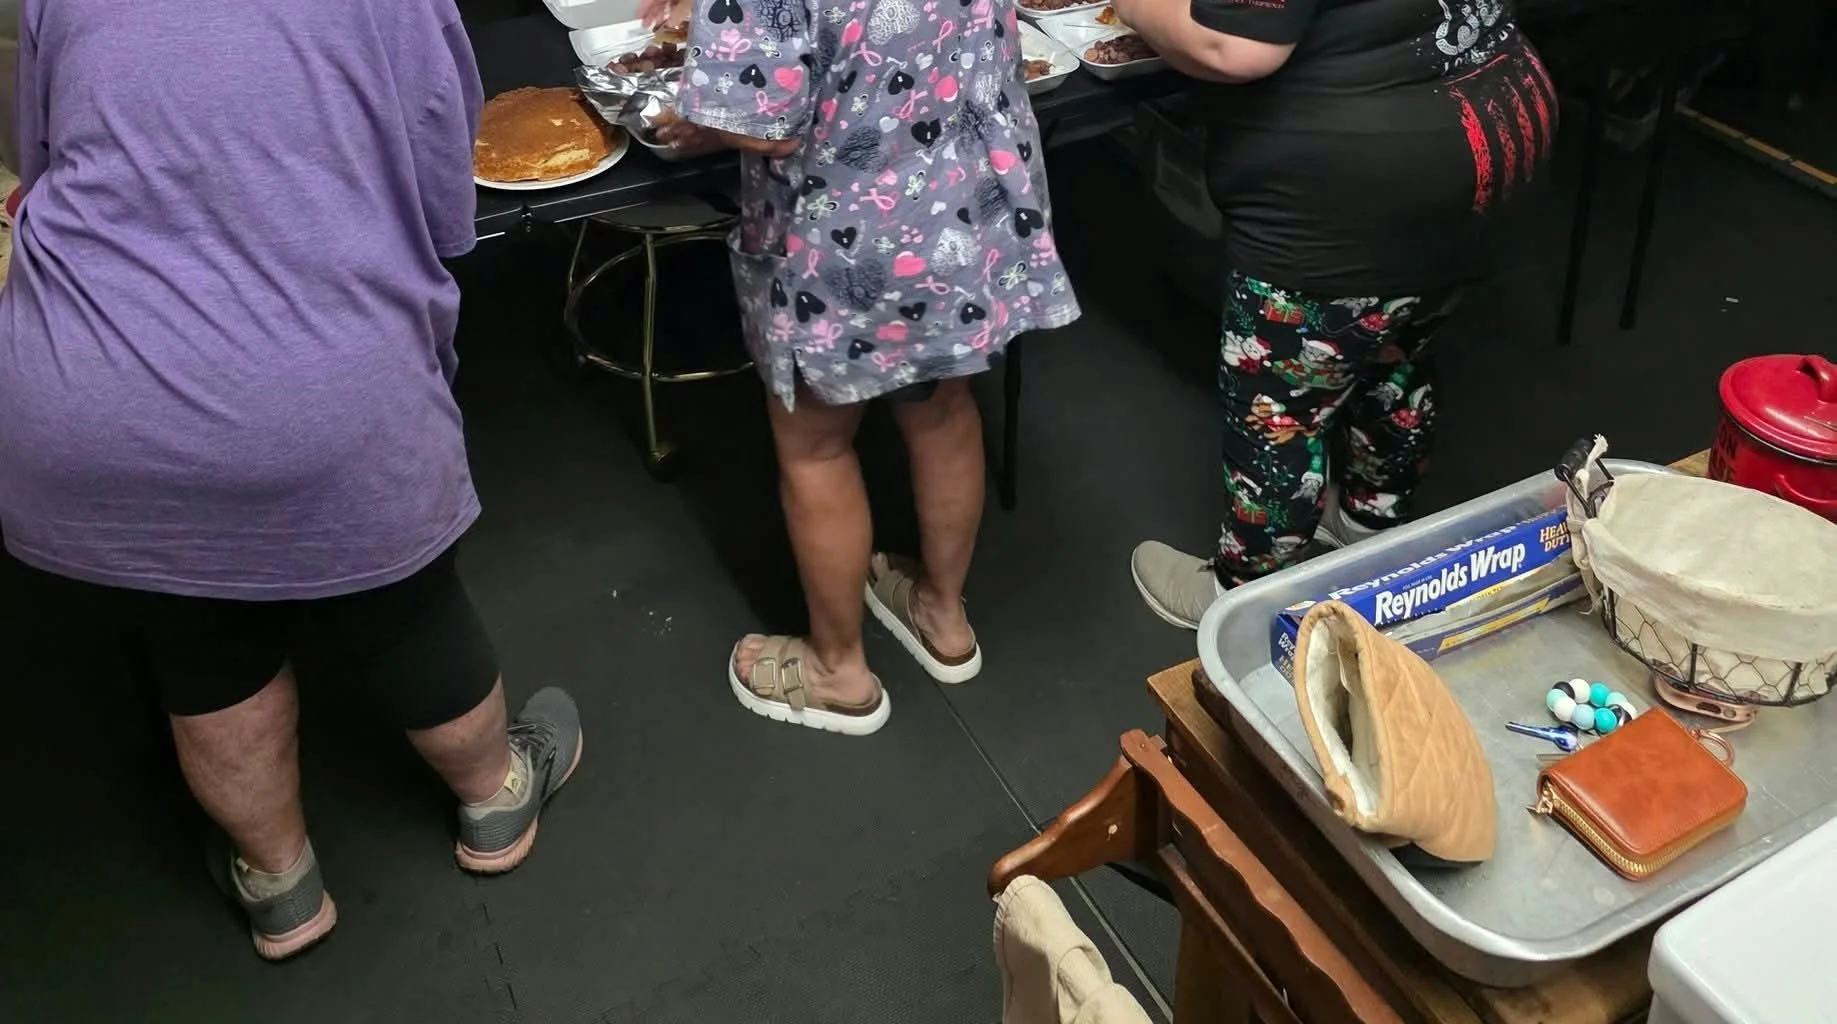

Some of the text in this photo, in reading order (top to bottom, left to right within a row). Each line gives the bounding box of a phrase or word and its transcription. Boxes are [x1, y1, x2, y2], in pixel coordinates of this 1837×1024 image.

[1328, 551, 1447, 600] Reynolds
[1374, 563, 1468, 626] Reynolds
[1470, 543, 1526, 582] Wrap
